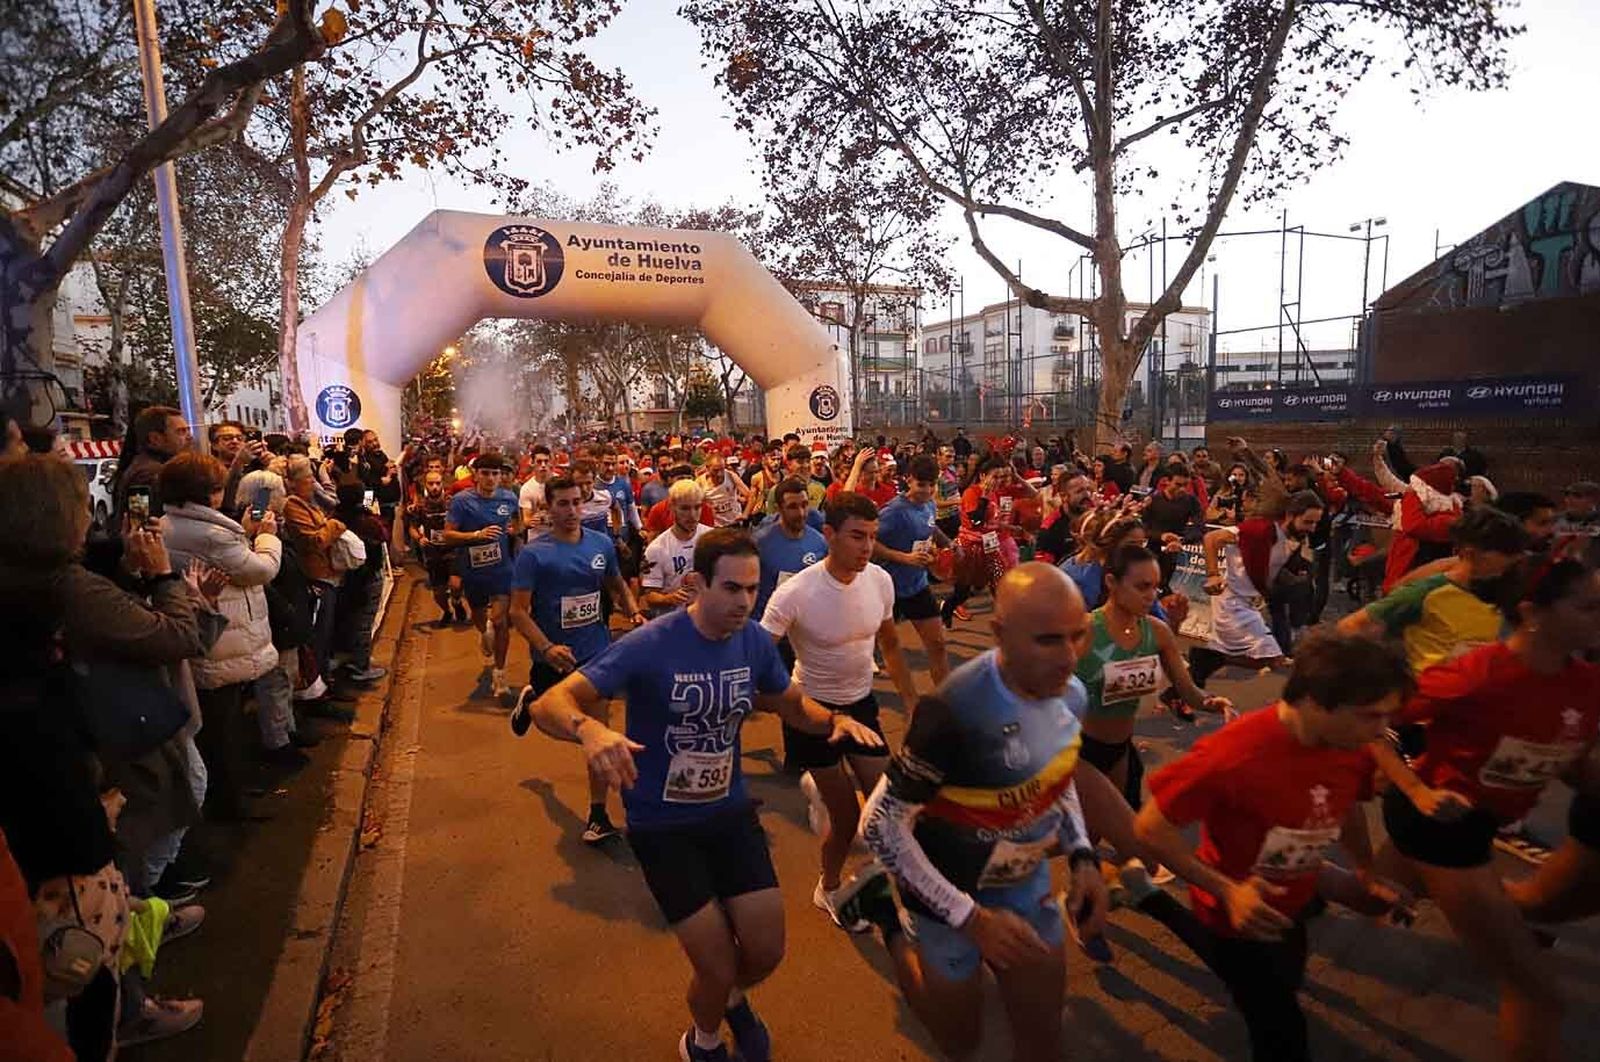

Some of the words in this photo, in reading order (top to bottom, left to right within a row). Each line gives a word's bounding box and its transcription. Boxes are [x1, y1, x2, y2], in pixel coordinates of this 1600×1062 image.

[567, 234, 701, 254] Ayuntamiento
[607, 252, 631, 268] de
[637, 254, 702, 271] Huelva
[638, 273, 653, 282] de
[655, 273, 705, 285] Deportes
[1394, 389, 1451, 400] HYUNDAI
[1494, 383, 1563, 397] HYUNDAI
[1234, 398, 1273, 407] HYUNDAI
[1301, 394, 1347, 404] HYUNDAI
[672, 555, 687, 573] 10
[579, 602, 598, 617] 594
[1127, 671, 1155, 689] 324
